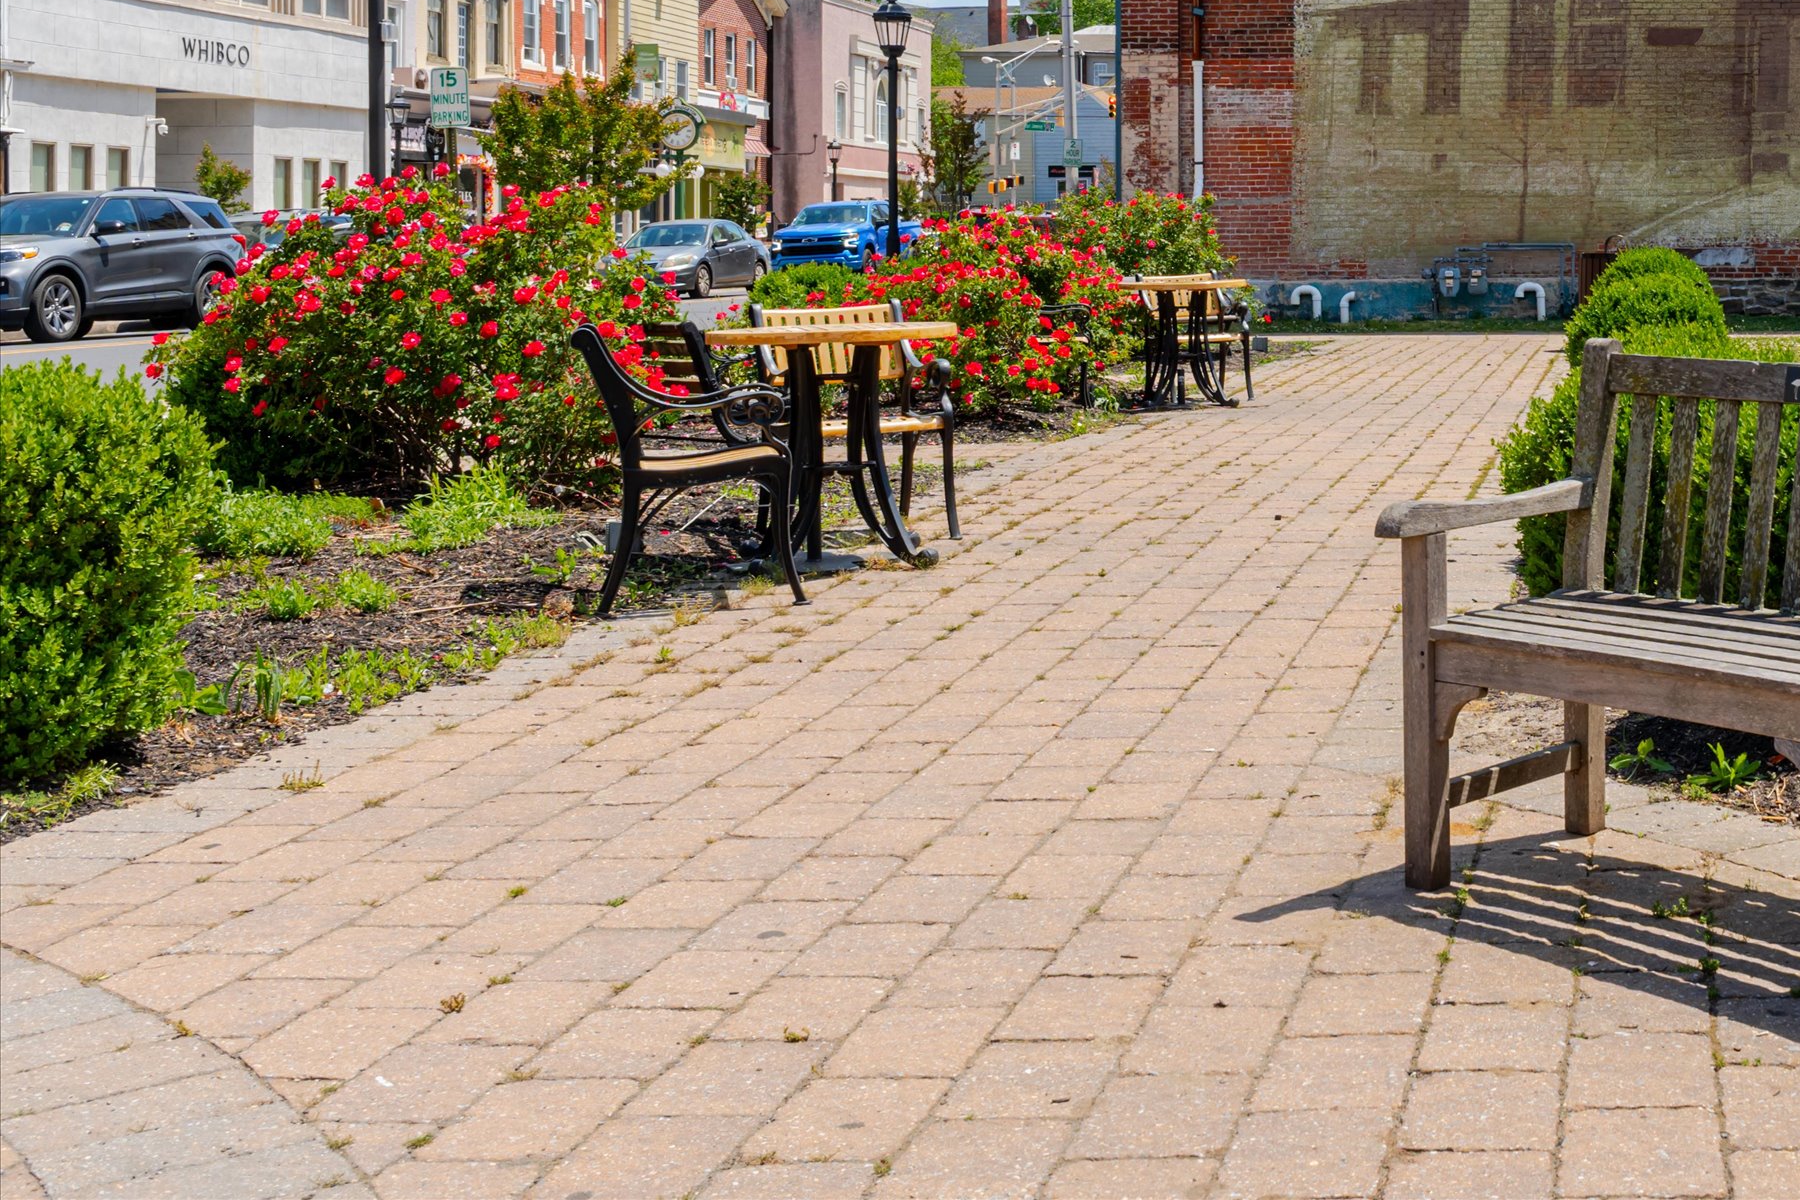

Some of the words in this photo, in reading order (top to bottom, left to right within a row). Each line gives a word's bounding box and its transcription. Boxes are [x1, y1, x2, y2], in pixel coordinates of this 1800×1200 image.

[182, 37, 250, 66] WHIBCO
[440, 71, 457, 88] 15
[432, 93, 467, 104] MINUTE
[433, 111, 468, 122] PARKING
